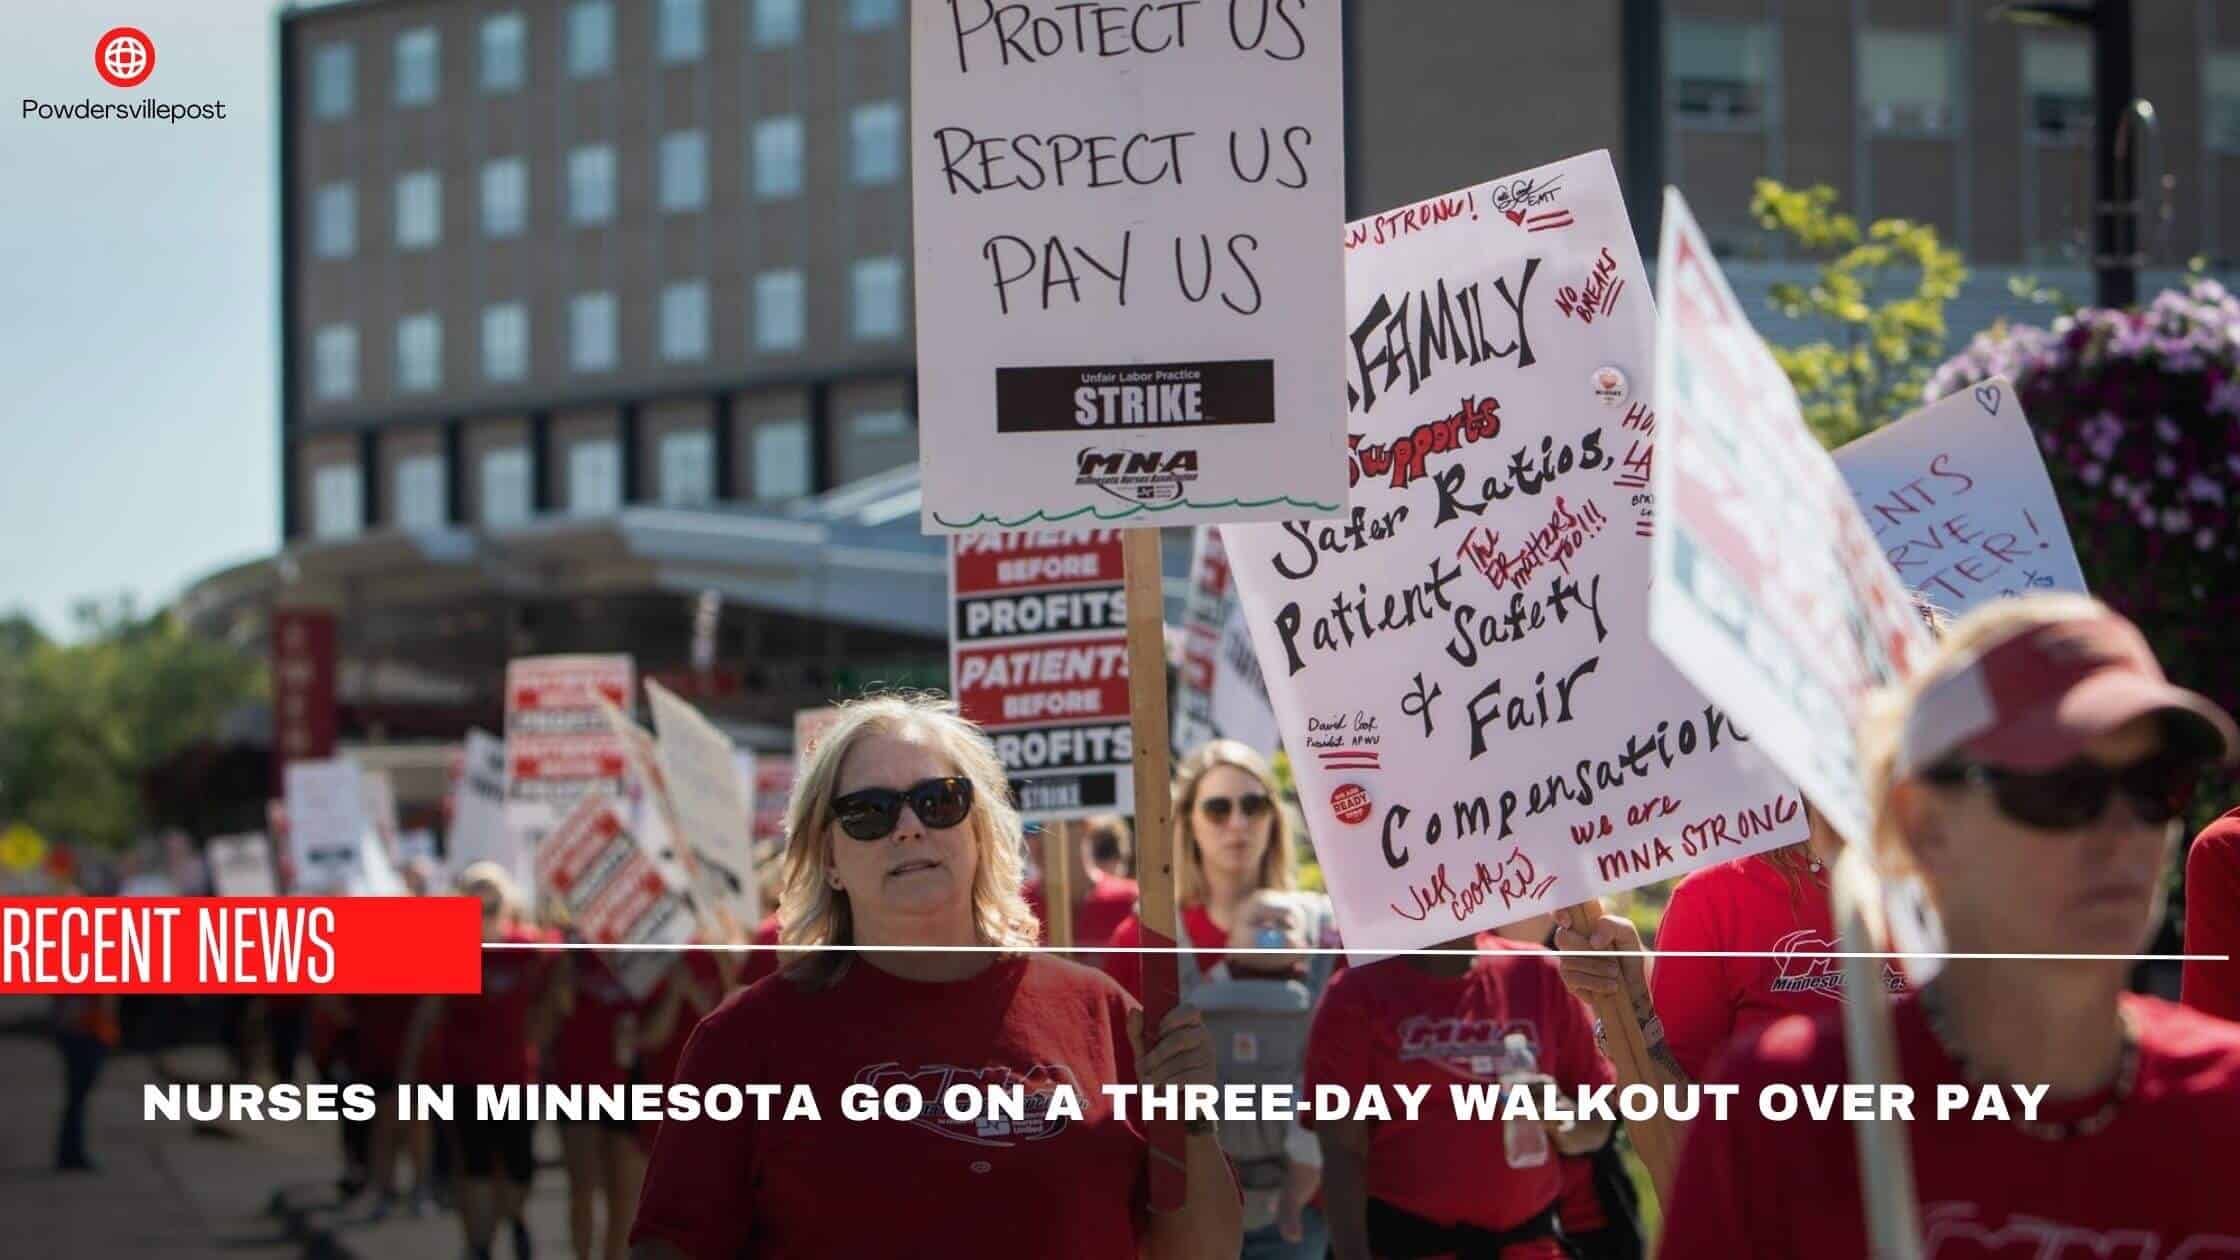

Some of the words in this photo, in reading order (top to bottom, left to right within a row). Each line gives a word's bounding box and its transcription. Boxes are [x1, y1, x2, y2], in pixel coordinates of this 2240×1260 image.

[948, 0, 1203, 73] PROTECT
[1229, 0, 1306, 61] US
[934, 126, 1196, 195] RESPECT
[1229, 126, 1312, 190] US
[983, 230, 1131, 315] PAY
[1175, 233, 1262, 316] US
[1555, 285, 1578, 318] NO
[1349, 257, 1543, 414] FAMILY
[1074, 383, 1203, 427] STRIKE
[1080, 372, 1117, 384] Unfair
[1119, 371, 1153, 383] Labor
[1155, 368, 1201, 381] Practice
[1079, 449, 1199, 476] MNA
[1271, 505, 1409, 580] Safer
[1433, 427, 1615, 529] Ratios,
[997, 553, 1100, 584] BEFORE
[1274, 556, 1462, 677] Patient
[1445, 573, 1608, 668] Safety
[1002, 689, 1102, 720] BEFORE
[1307, 713, 1347, 732] David
[1466, 655, 1600, 760] Fair
[1381, 704, 1750, 869] Compensation
[1626, 795, 1682, 826] are
[1597, 836, 1675, 882] MNA
[1680, 794, 1799, 858] STRONG
